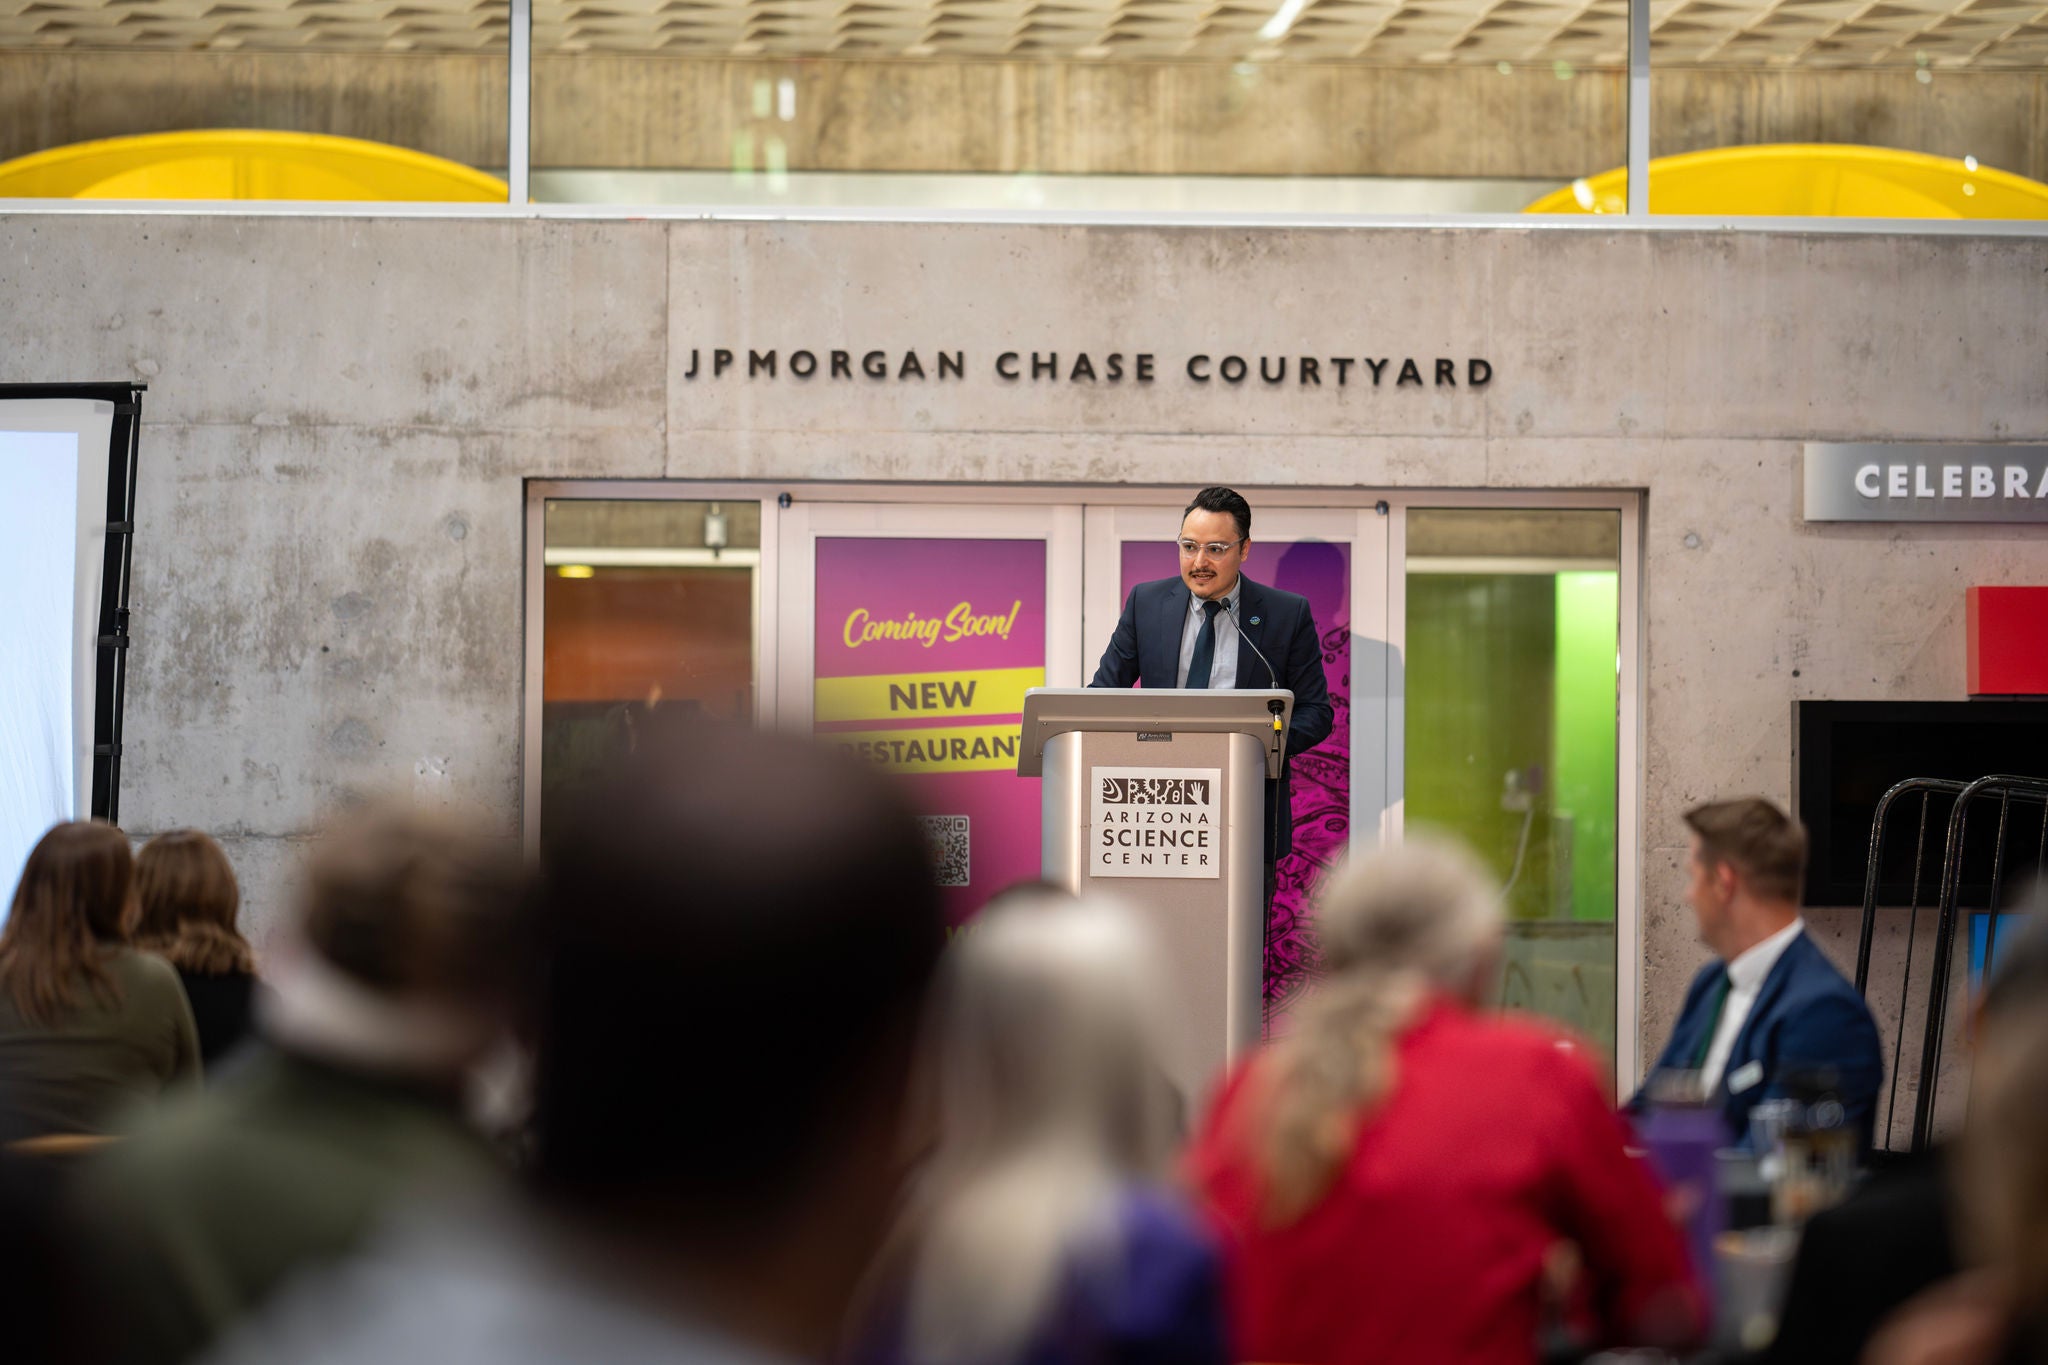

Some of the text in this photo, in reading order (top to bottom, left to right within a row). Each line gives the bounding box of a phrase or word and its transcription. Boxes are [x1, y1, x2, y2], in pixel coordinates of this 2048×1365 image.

[684, 349, 1493, 386] JPMORGAN CHASE COURTYARD
[843, 600, 1021, 647] Coming Soon!
[889, 680, 977, 711] NEW
[1104, 811, 1209, 824] ARIZONA
[1102, 829, 1209, 848] SCIENCE
[1102, 853, 1208, 865] CENTER
